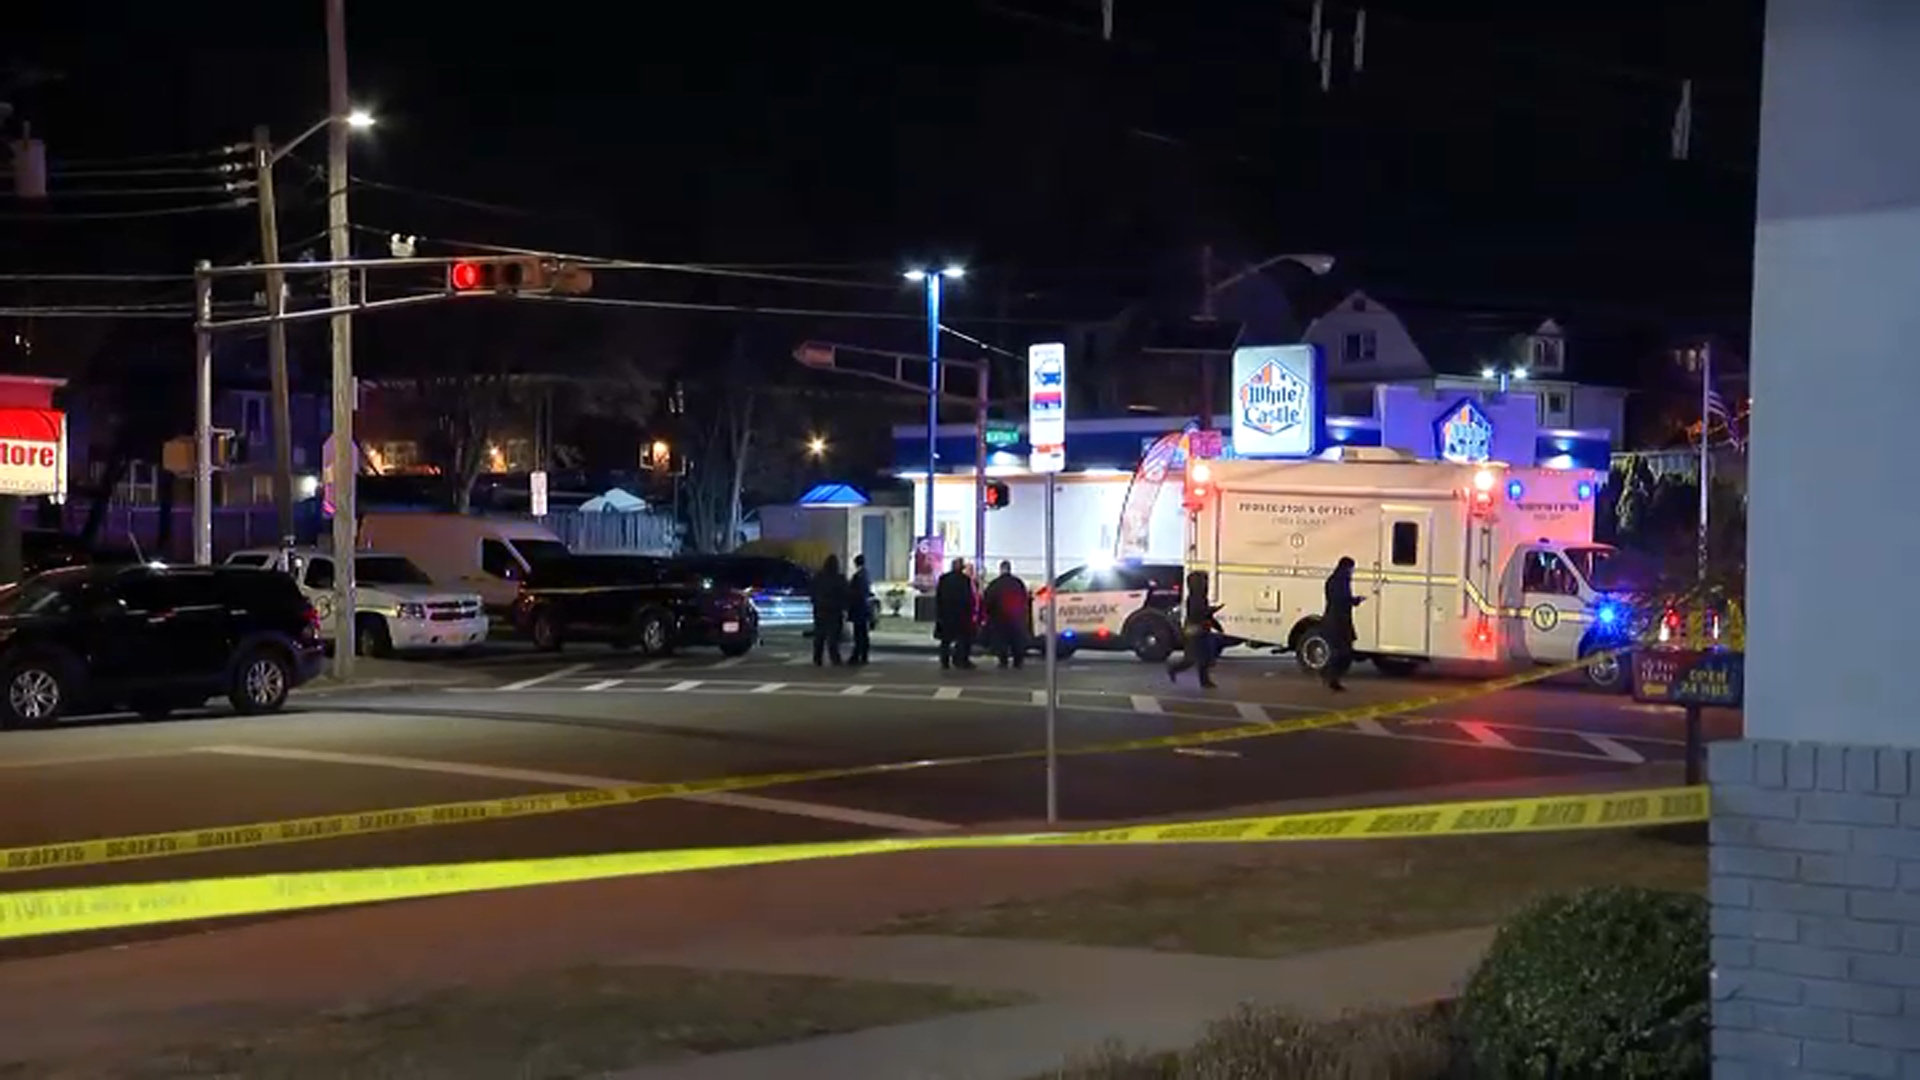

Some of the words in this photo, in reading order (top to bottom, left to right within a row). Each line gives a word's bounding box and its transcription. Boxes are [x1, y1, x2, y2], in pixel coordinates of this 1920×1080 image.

[1249, 386, 1297, 405] White
[1244, 406, 1300, 424] Castle
[1058, 604, 1120, 617] NEWARK
